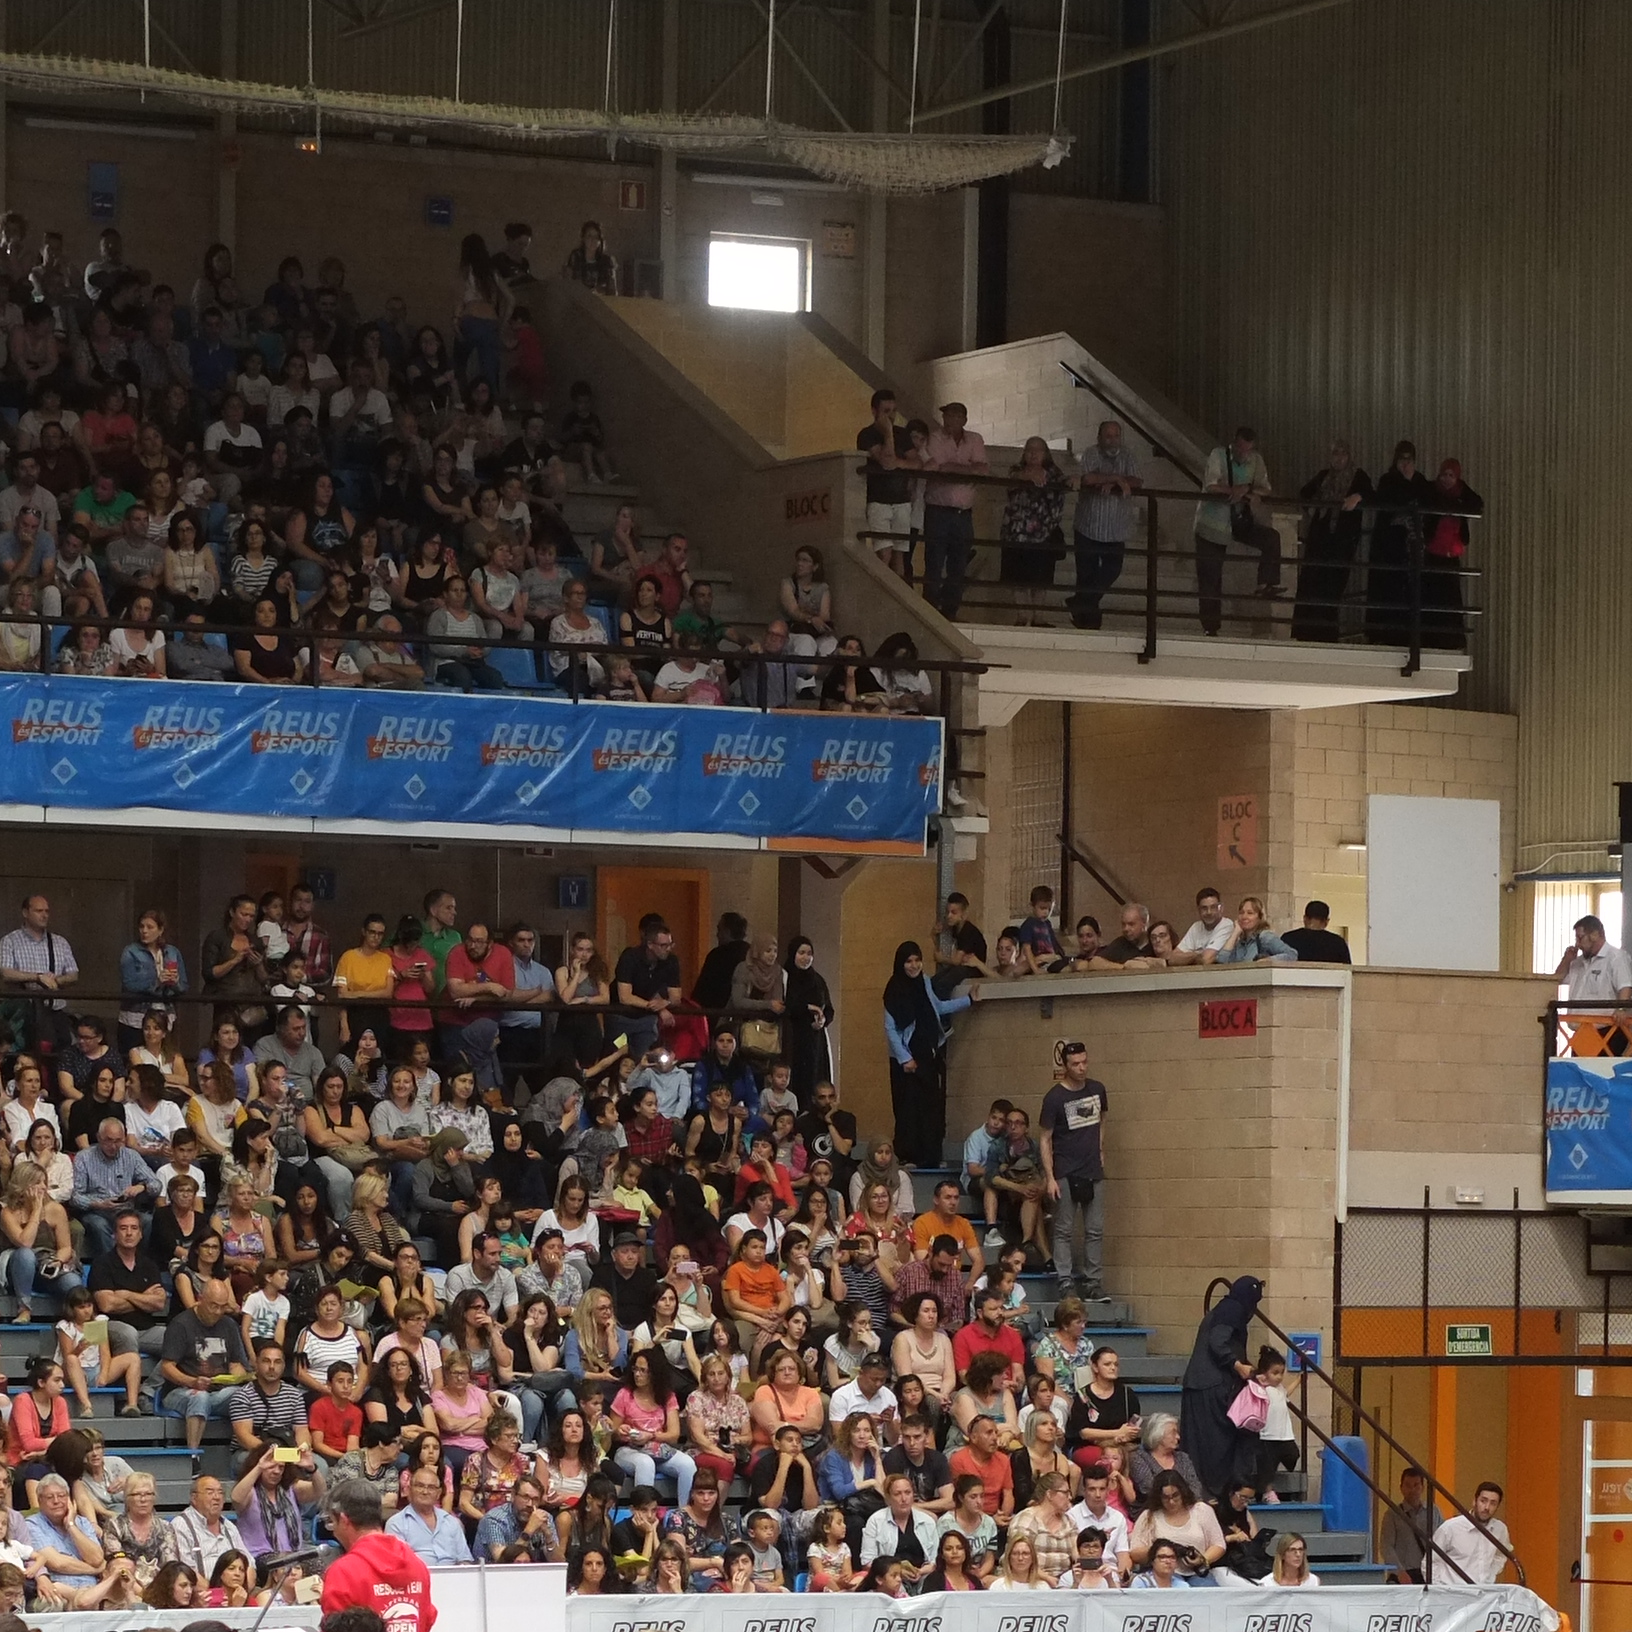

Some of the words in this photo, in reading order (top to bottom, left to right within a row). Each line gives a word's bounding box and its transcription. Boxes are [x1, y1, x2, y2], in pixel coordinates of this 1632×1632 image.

[786, 495, 818, 520] BLOC
[821, 493, 829, 514] C
[21, 698, 105, 728] REUS
[29, 725, 104, 746] ESPORT
[377, 716, 455, 745] REUS
[383, 742, 453, 762] ESPORT
[821, 739, 893, 766] REUS
[826, 765, 893, 784] ESPORT
[1221, 801, 1253, 821] BLOC
[1233, 822, 1242, 842] C
[1201, 1006, 1243, 1033] BLOC
[1244, 1005, 1255, 1029] A
